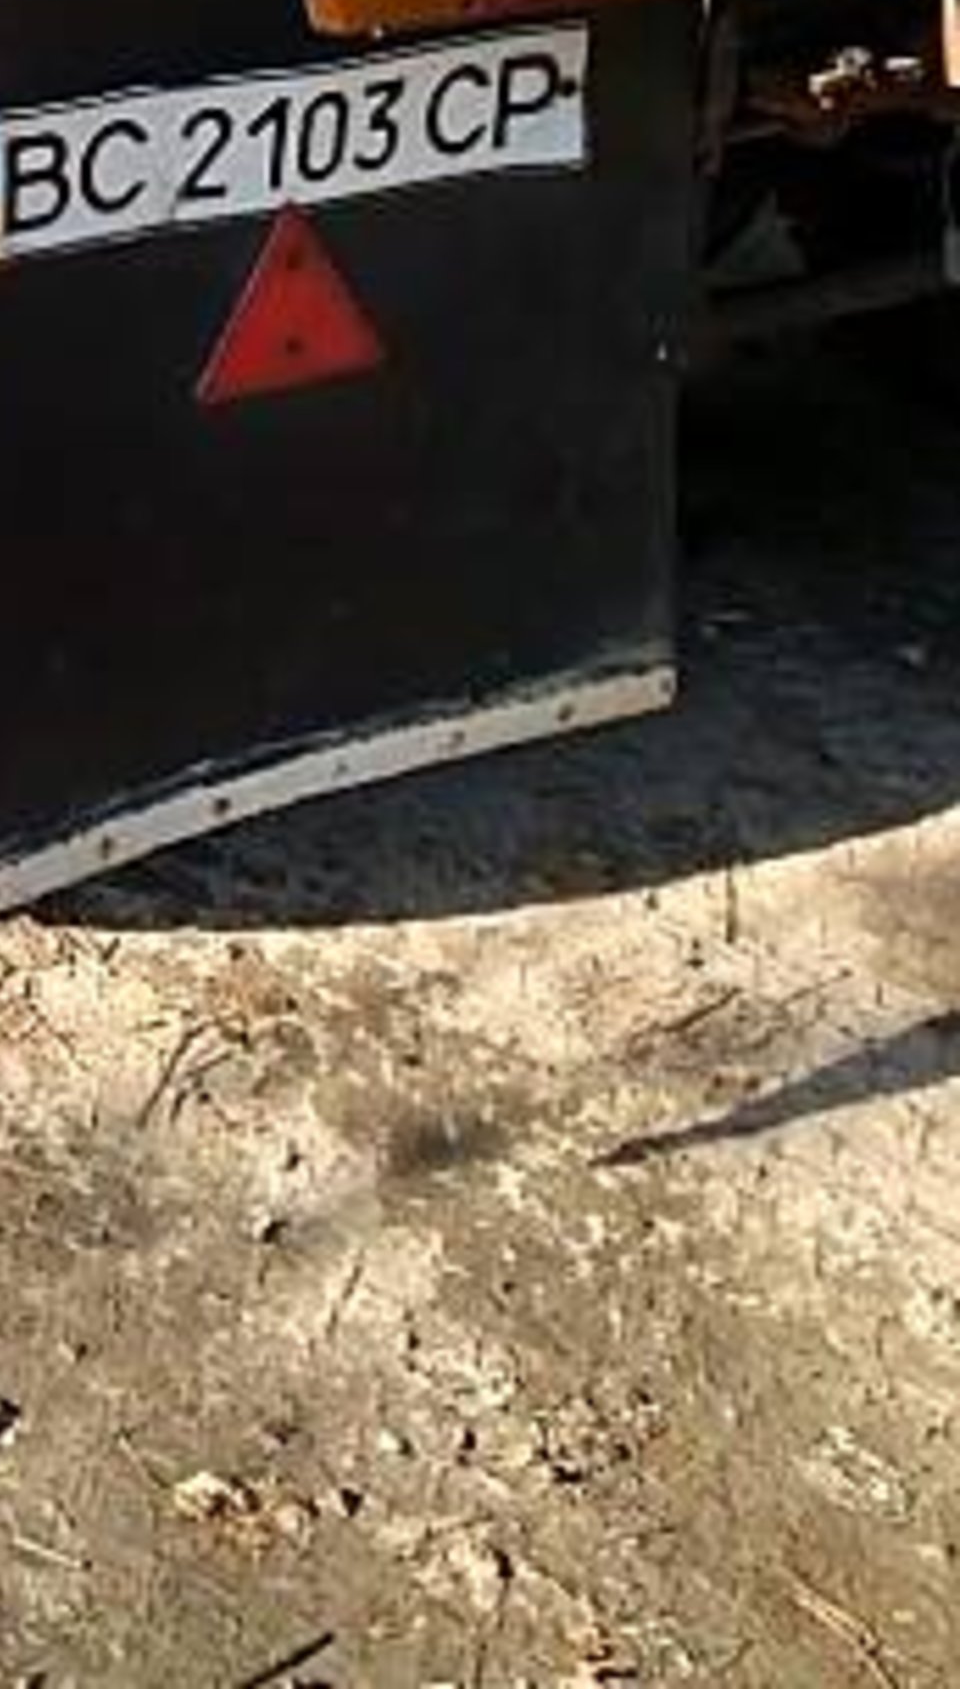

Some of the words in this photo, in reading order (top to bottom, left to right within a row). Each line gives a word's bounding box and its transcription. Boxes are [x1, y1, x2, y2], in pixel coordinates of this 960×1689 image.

[4, 119, 149, 233] BC
[178, 79, 404, 200] 2103
[426, 54, 559, 154] CP
